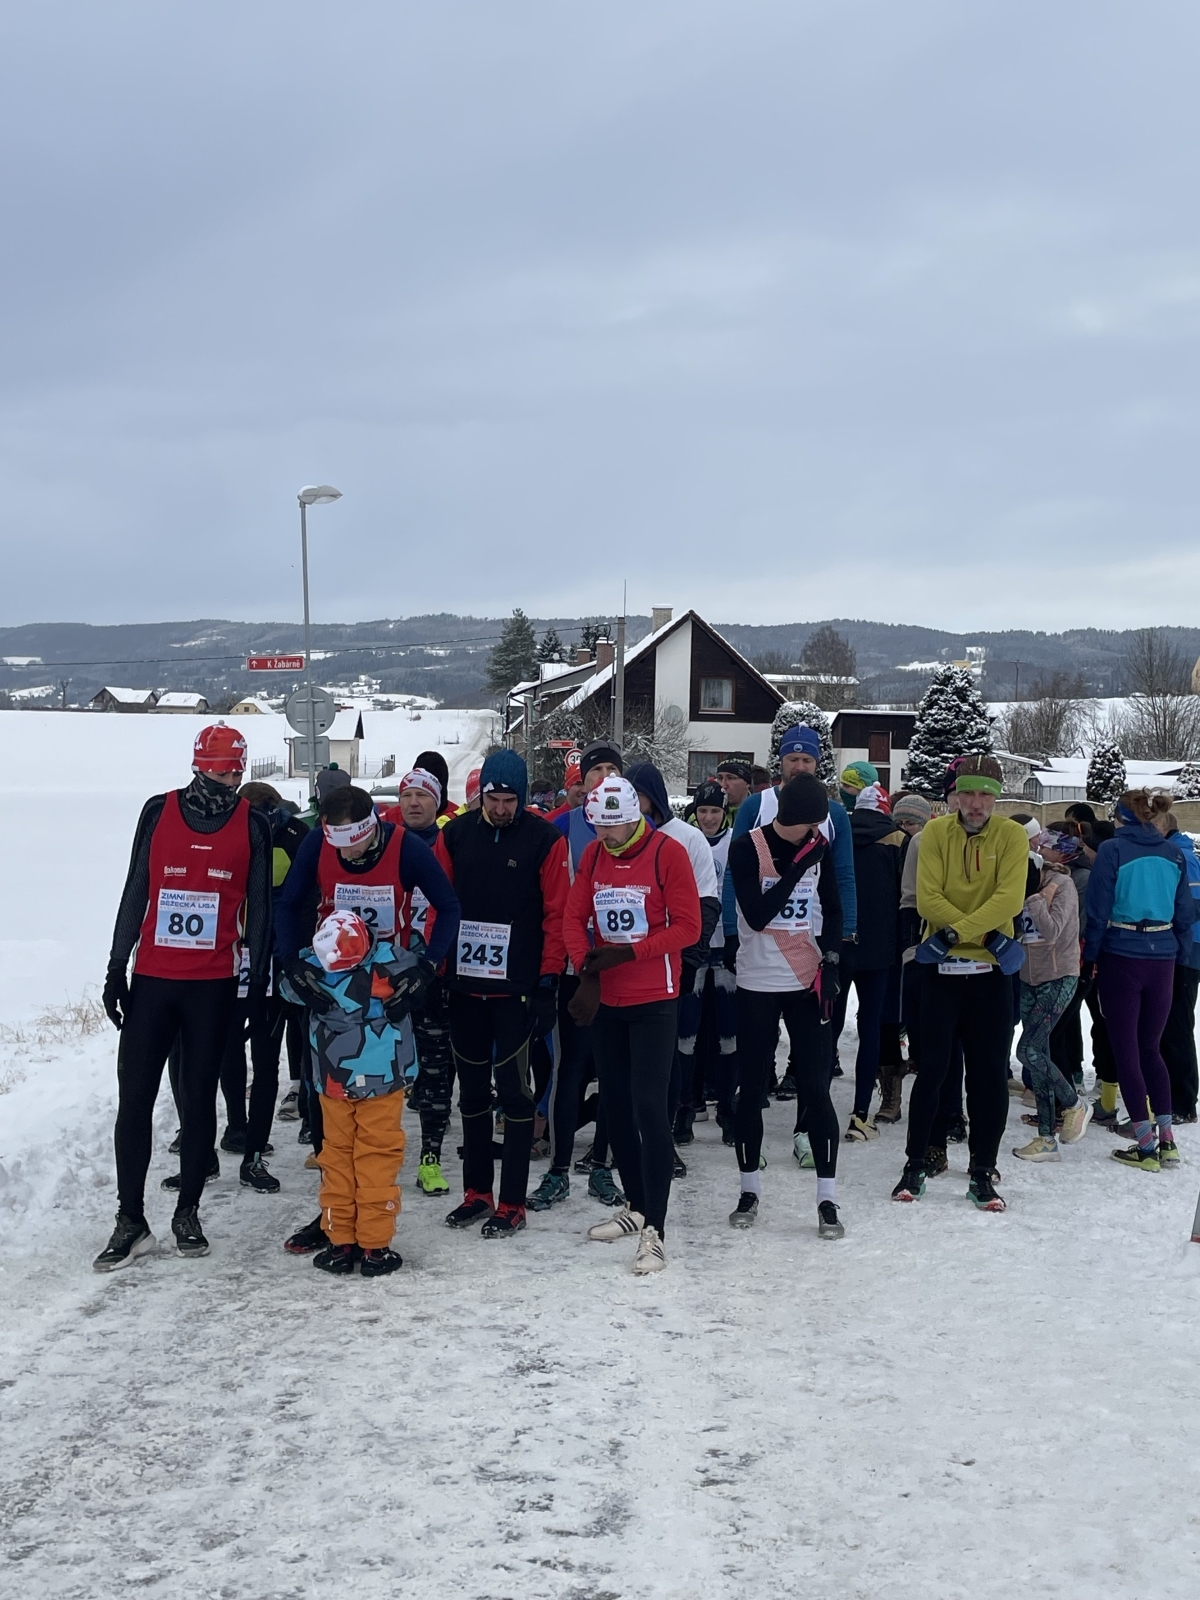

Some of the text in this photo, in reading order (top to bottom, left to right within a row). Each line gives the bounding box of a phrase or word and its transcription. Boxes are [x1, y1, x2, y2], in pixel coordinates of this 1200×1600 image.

[267, 659, 300, 668] K Žabárně
[161, 891, 185, 901] ZIMNÍ
[337, 887, 360, 895] ZIMNÍ
[168, 913, 204, 937] 80
[607, 909, 635, 932] 89
[461, 923, 480, 931] ZIMNÍ
[461, 942, 504, 967] 243
